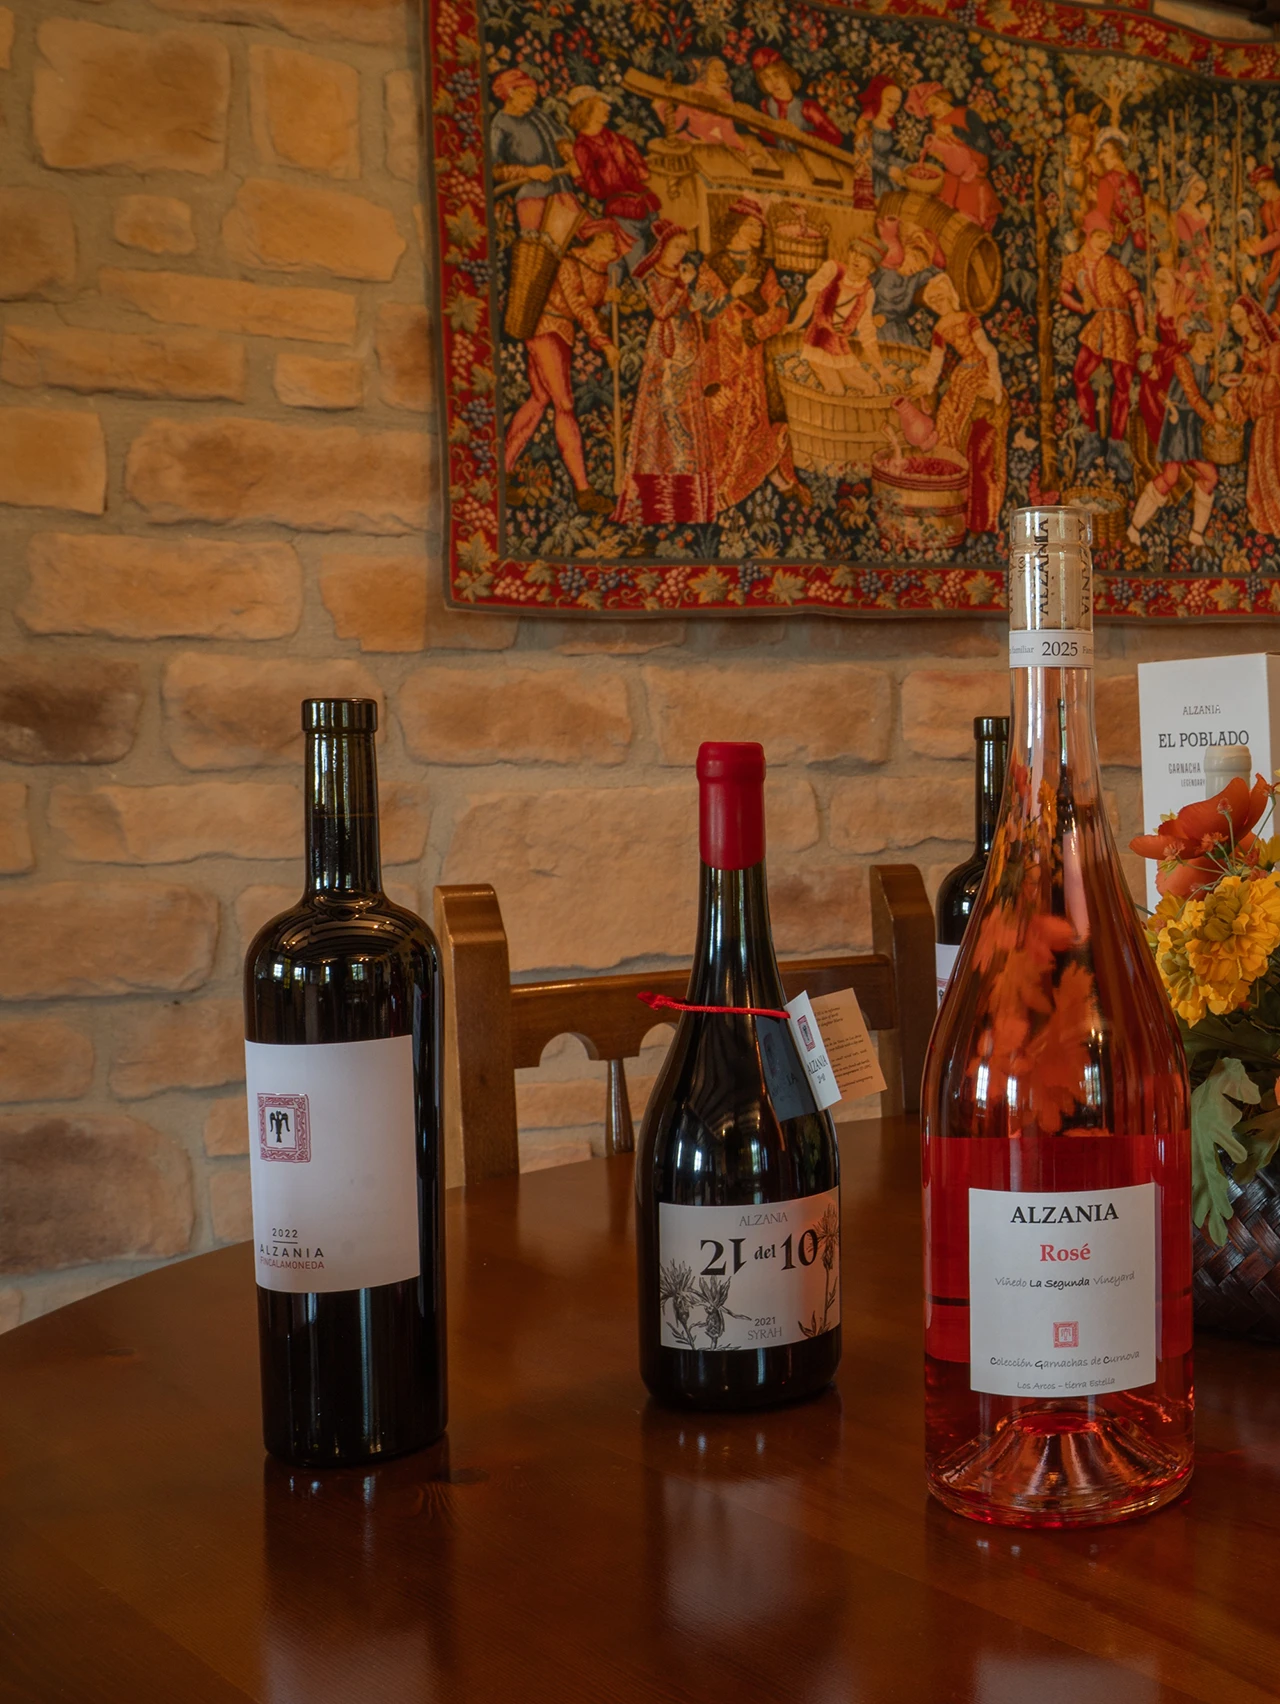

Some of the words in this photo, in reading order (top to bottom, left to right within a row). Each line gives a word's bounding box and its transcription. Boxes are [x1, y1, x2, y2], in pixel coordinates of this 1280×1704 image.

[1041, 641, 1078, 656] 2025
[1183, 705, 1221, 716] ALZANIA
[1158, 733, 1176, 748] EL
[1179, 730, 1250, 747] POBLADO
[1168, 762, 1201, 774] GARNACHA
[739, 1212, 788, 1226] ALZANIA
[1010, 1202, 1119, 1224] ALZANIA
[272, 1228, 298, 1238] 2022
[260, 1244, 324, 1258] ALZANIA
[754, 1244, 777, 1260] del
[780, 1229, 818, 1271] 10
[1040, 1243, 1091, 1262] Rosé
[260, 1256, 325, 1269] FINCALAMONEDA
[995, 1276, 1027, 1288] Viñedo
[1029, 1279, 1042, 1288] La
[1044, 1277, 1090, 1290] Segunda
[1093, 1271, 1135, 1287] Vineyard
[754, 1317, 776, 1327] 2021
[747, 1327, 782, 1341] SYRAH
[990, 1356, 1033, 1368] Colección
[1034, 1358, 1088, 1369] Garnachas
[1091, 1356, 1101, 1365] de
[1017, 1382, 1031, 1390] Los
[1033, 1382, 1056, 1390] Arcos
